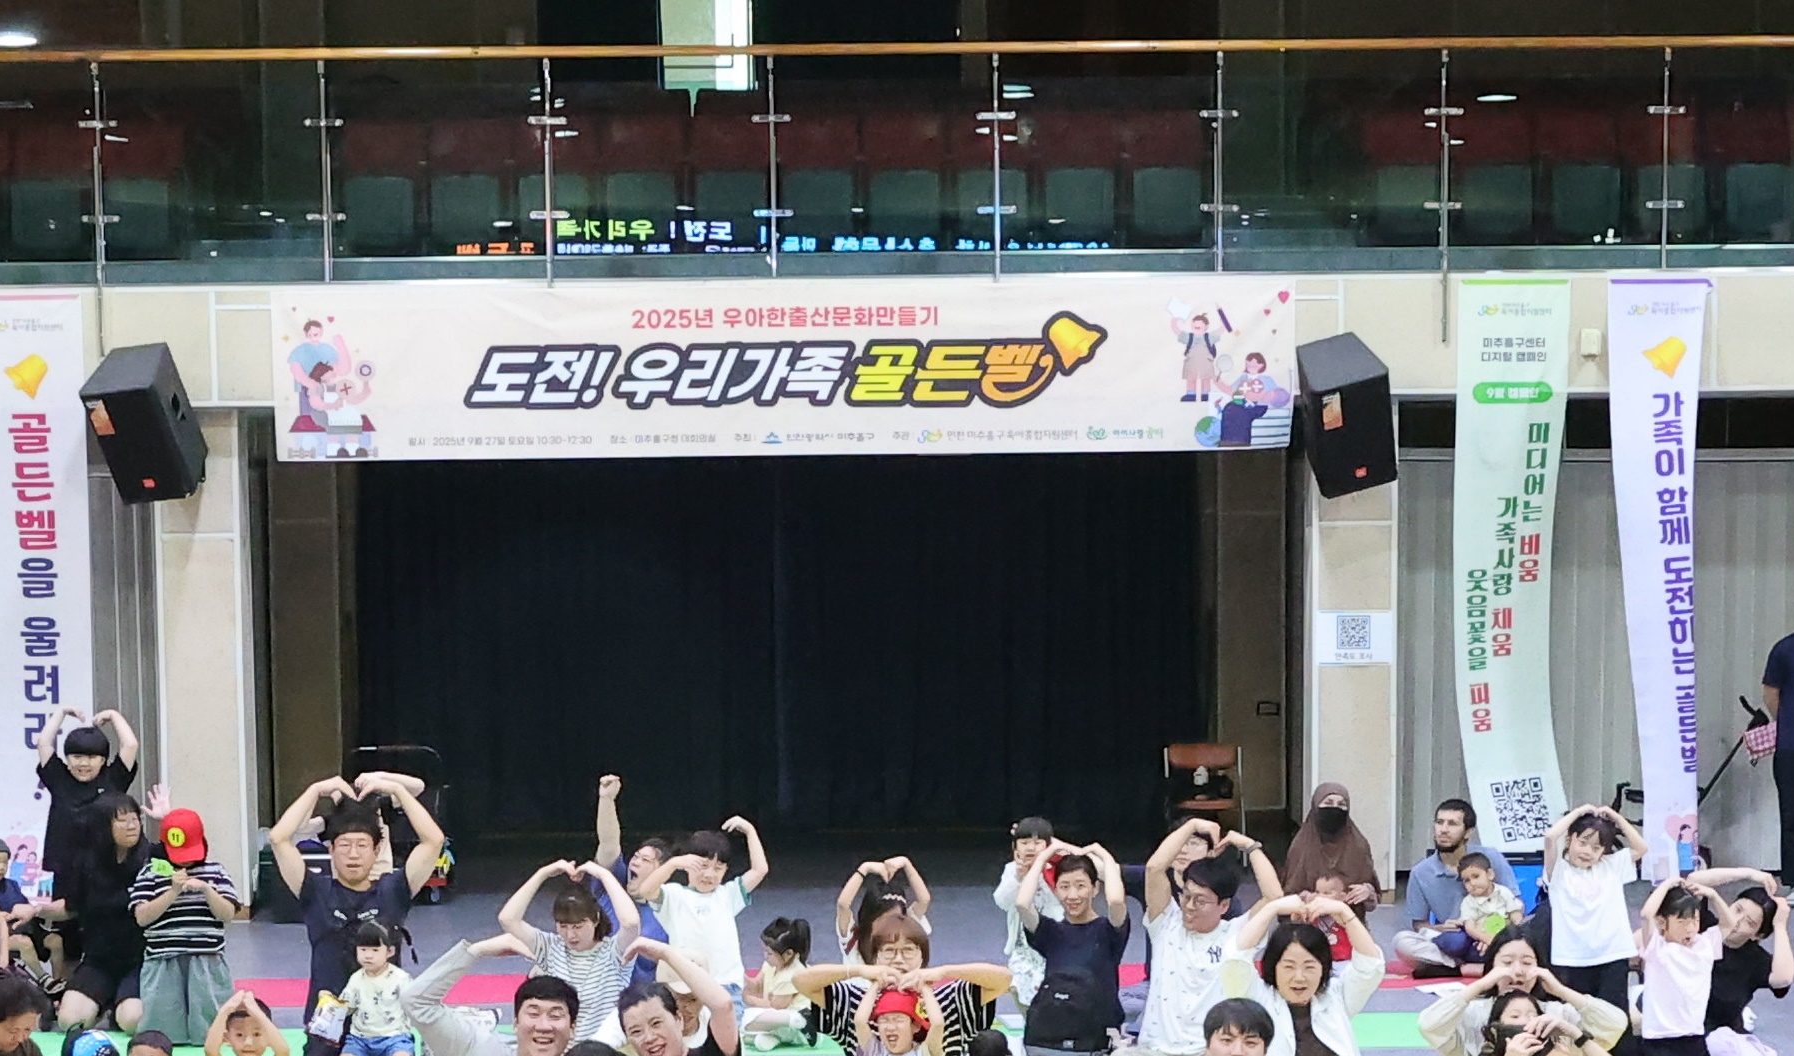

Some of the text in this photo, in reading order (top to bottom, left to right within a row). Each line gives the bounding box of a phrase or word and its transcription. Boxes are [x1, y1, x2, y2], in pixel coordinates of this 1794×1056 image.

[631, 305, 939, 329] 2025년 우아한출산문화만들기
[467, 341, 1055, 406] 도전! 우리가족 골든벨
[1652, 391, 1686, 477] 가족이
[1518, 422, 1550, 583] 미디어는 비움
[1655, 486, 1691, 546] 함께
[8, 413, 64, 801] 골든벨을 울려라
[1491, 496, 1519, 657] 가족사랑 채움
[1469, 682, 1492, 732] 피움
